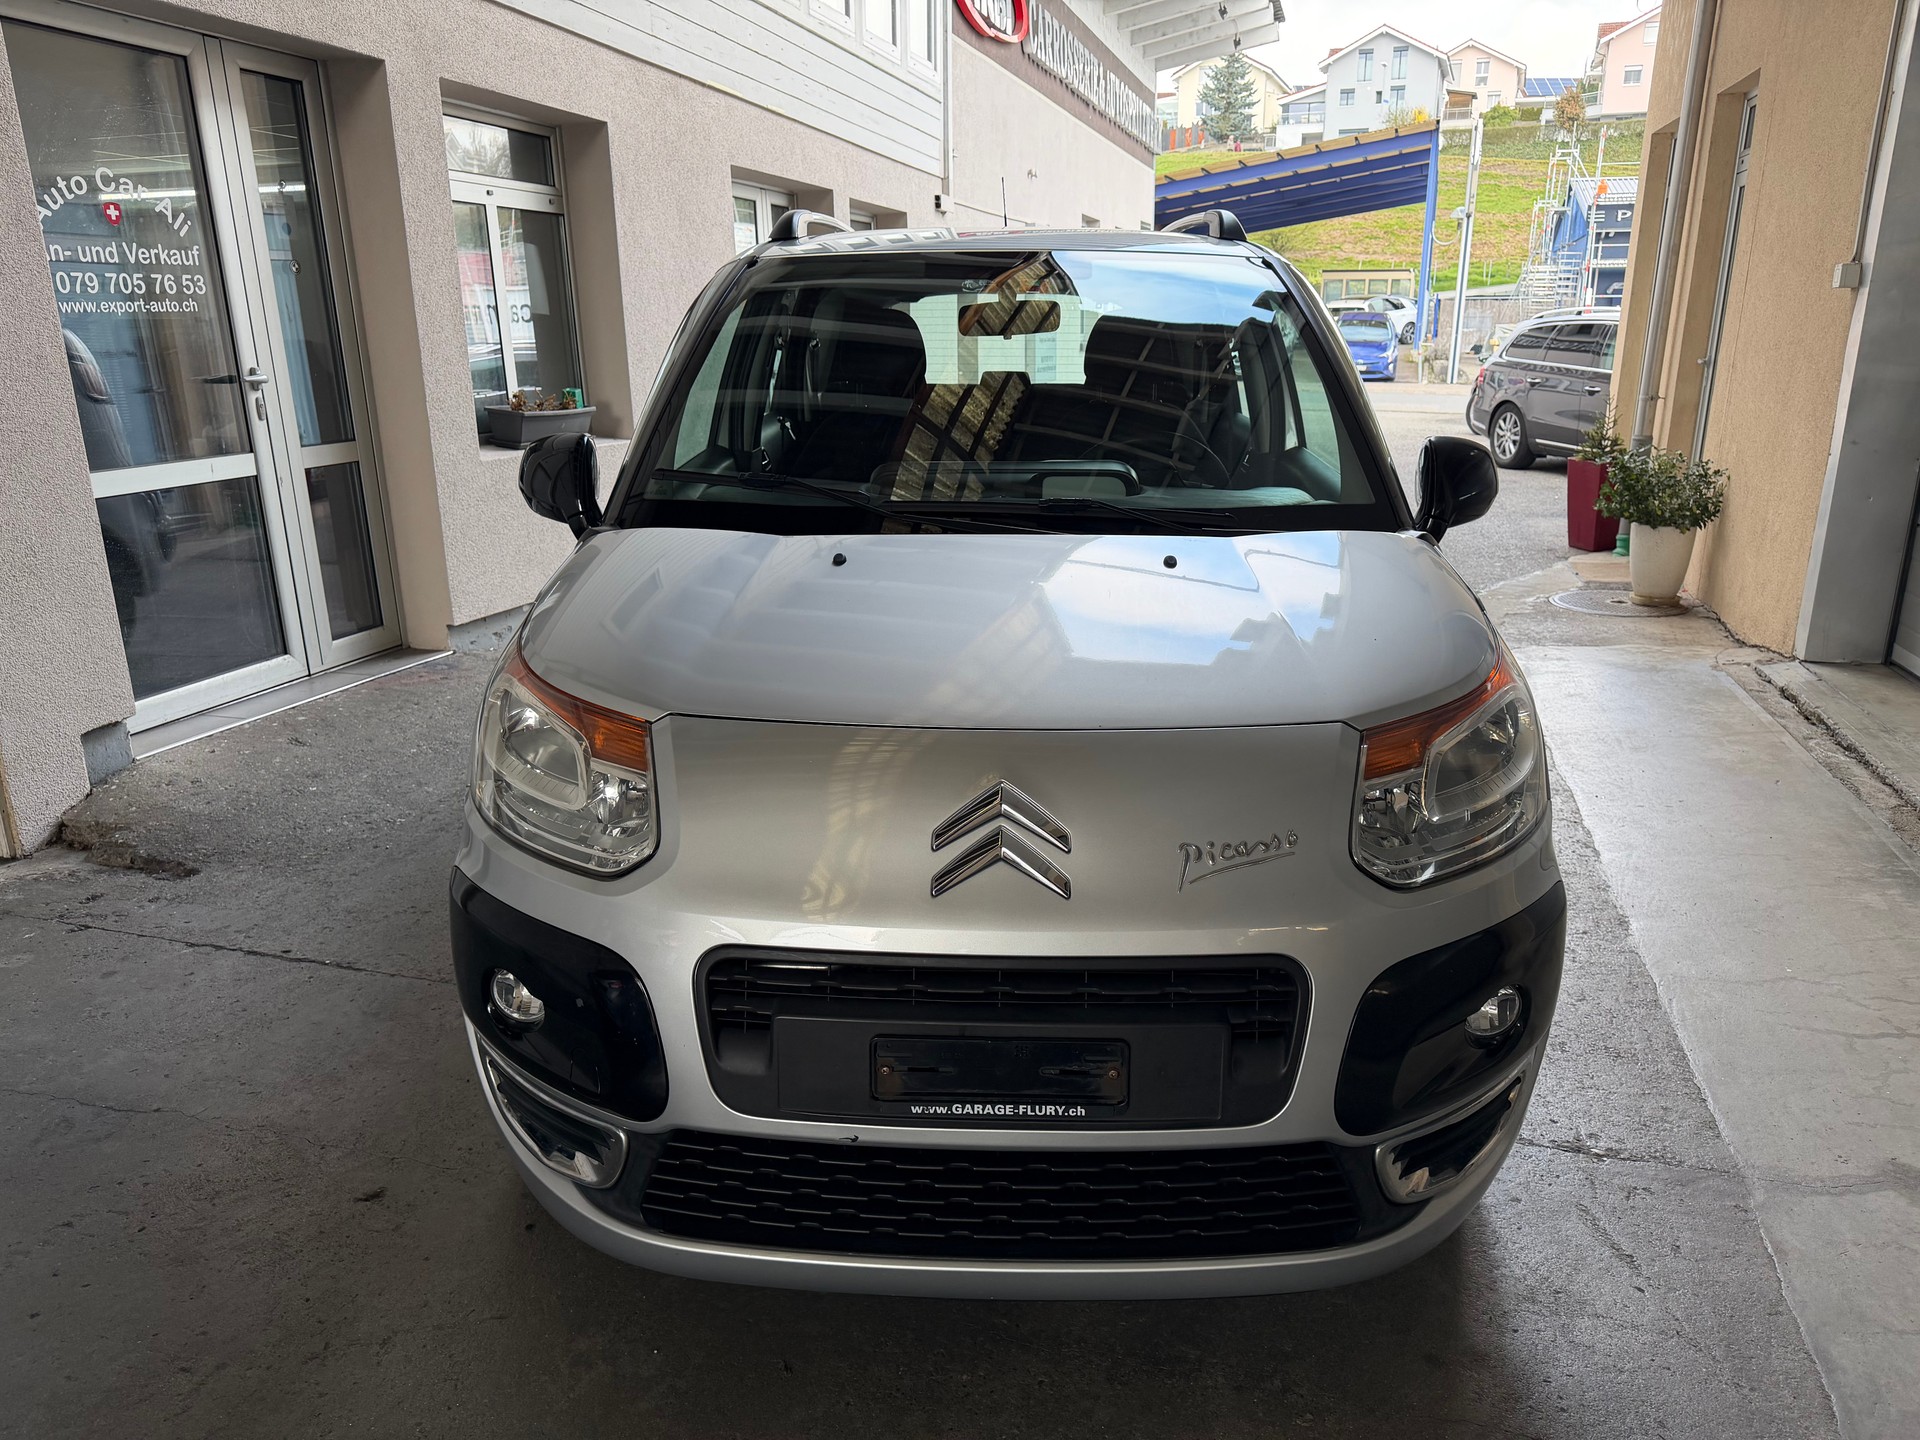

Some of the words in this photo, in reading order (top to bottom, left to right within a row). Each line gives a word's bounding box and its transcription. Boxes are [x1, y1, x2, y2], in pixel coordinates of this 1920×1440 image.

[1028, 0, 1099, 107] CARROSSERIE
[37, 175, 87, 230] Auto
[95, 166, 148, 201] Car
[155, 197, 191, 237] Ali
[48, 244, 71, 262] n-
[77, 241, 118, 263] und
[122, 242, 200, 266] Verkauf
[55, 271, 99, 294] 079
[104, 272, 146, 294] 705
[150, 273, 177, 295] 76
[182, 274, 206, 295] 53
[58, 298, 199, 316] www.export-auto.ch
[1177, 829, 1299, 893] Picasso
[910, 1103, 1086, 1117] www.GARAGE-FLURY.ch
